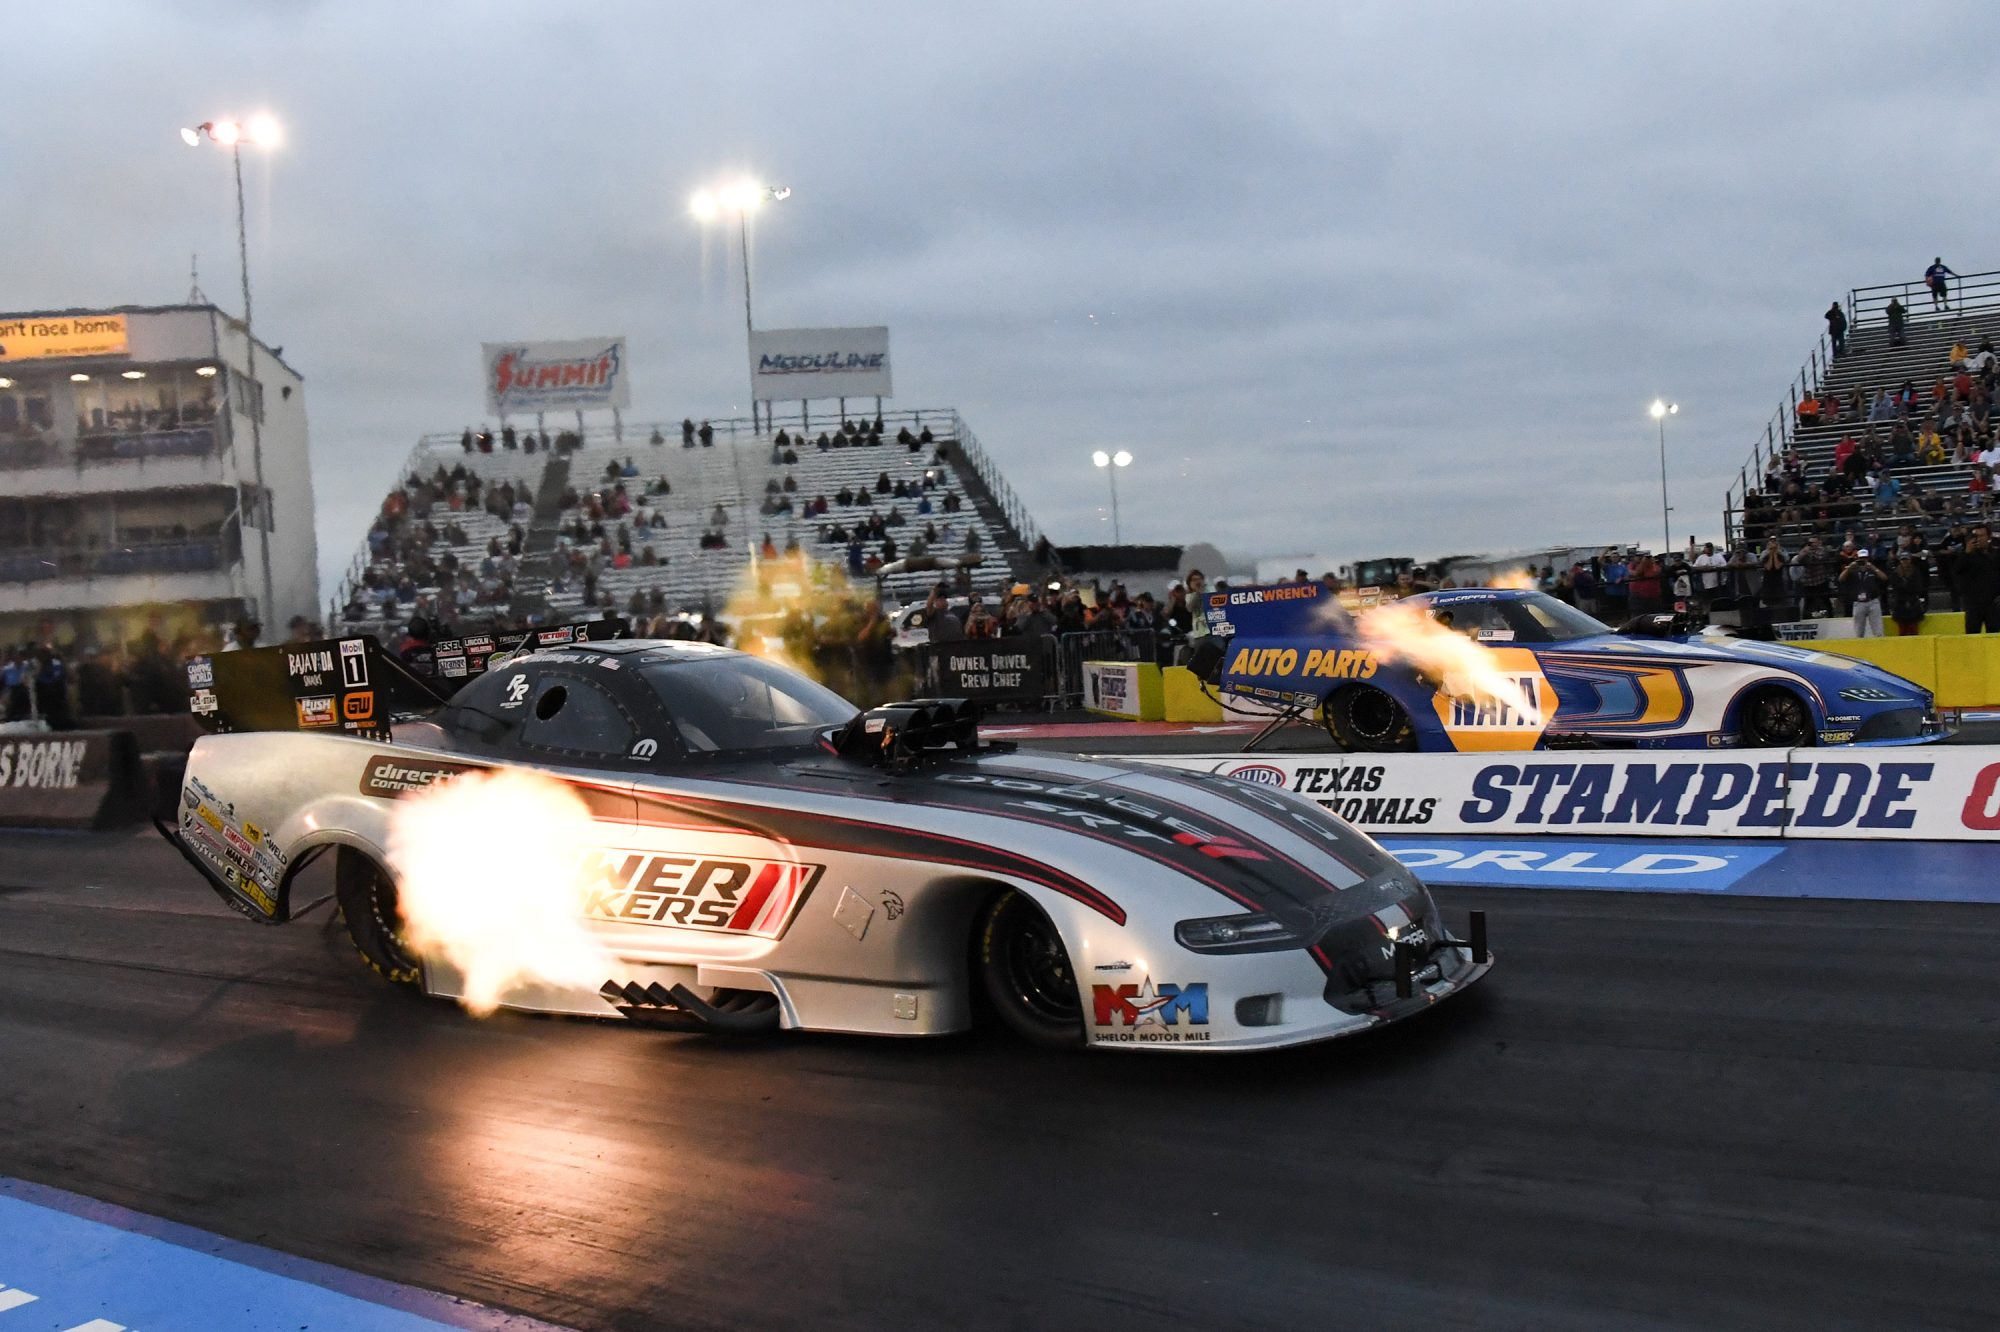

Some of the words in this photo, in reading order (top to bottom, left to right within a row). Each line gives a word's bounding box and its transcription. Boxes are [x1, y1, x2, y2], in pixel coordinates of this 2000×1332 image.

[31, 323, 69, 336] race
[1231, 586, 1317, 605] GEARWRENCH
[341, 643, 363, 654] Mobil
[437, 641, 463, 652] JESEL
[349, 656, 359, 682] 1
[1229, 648, 1298, 676] AUTO
[1302, 649, 1378, 679] PARTS
[1293, 766, 1385, 793] TEXAS
[1459, 763, 1935, 829] STAMPEDE
[225, 827, 252, 855] SIMPSON
[268, 841, 288, 865] WELD
[1389, 848, 1728, 875] ORLD
[584, 890, 738, 927] KERS
[1095, 1033, 1135, 1042] SHELOR
[1140, 1033, 1180, 1042] MOTOR
[1185, 1032, 1211, 1041] MILE
